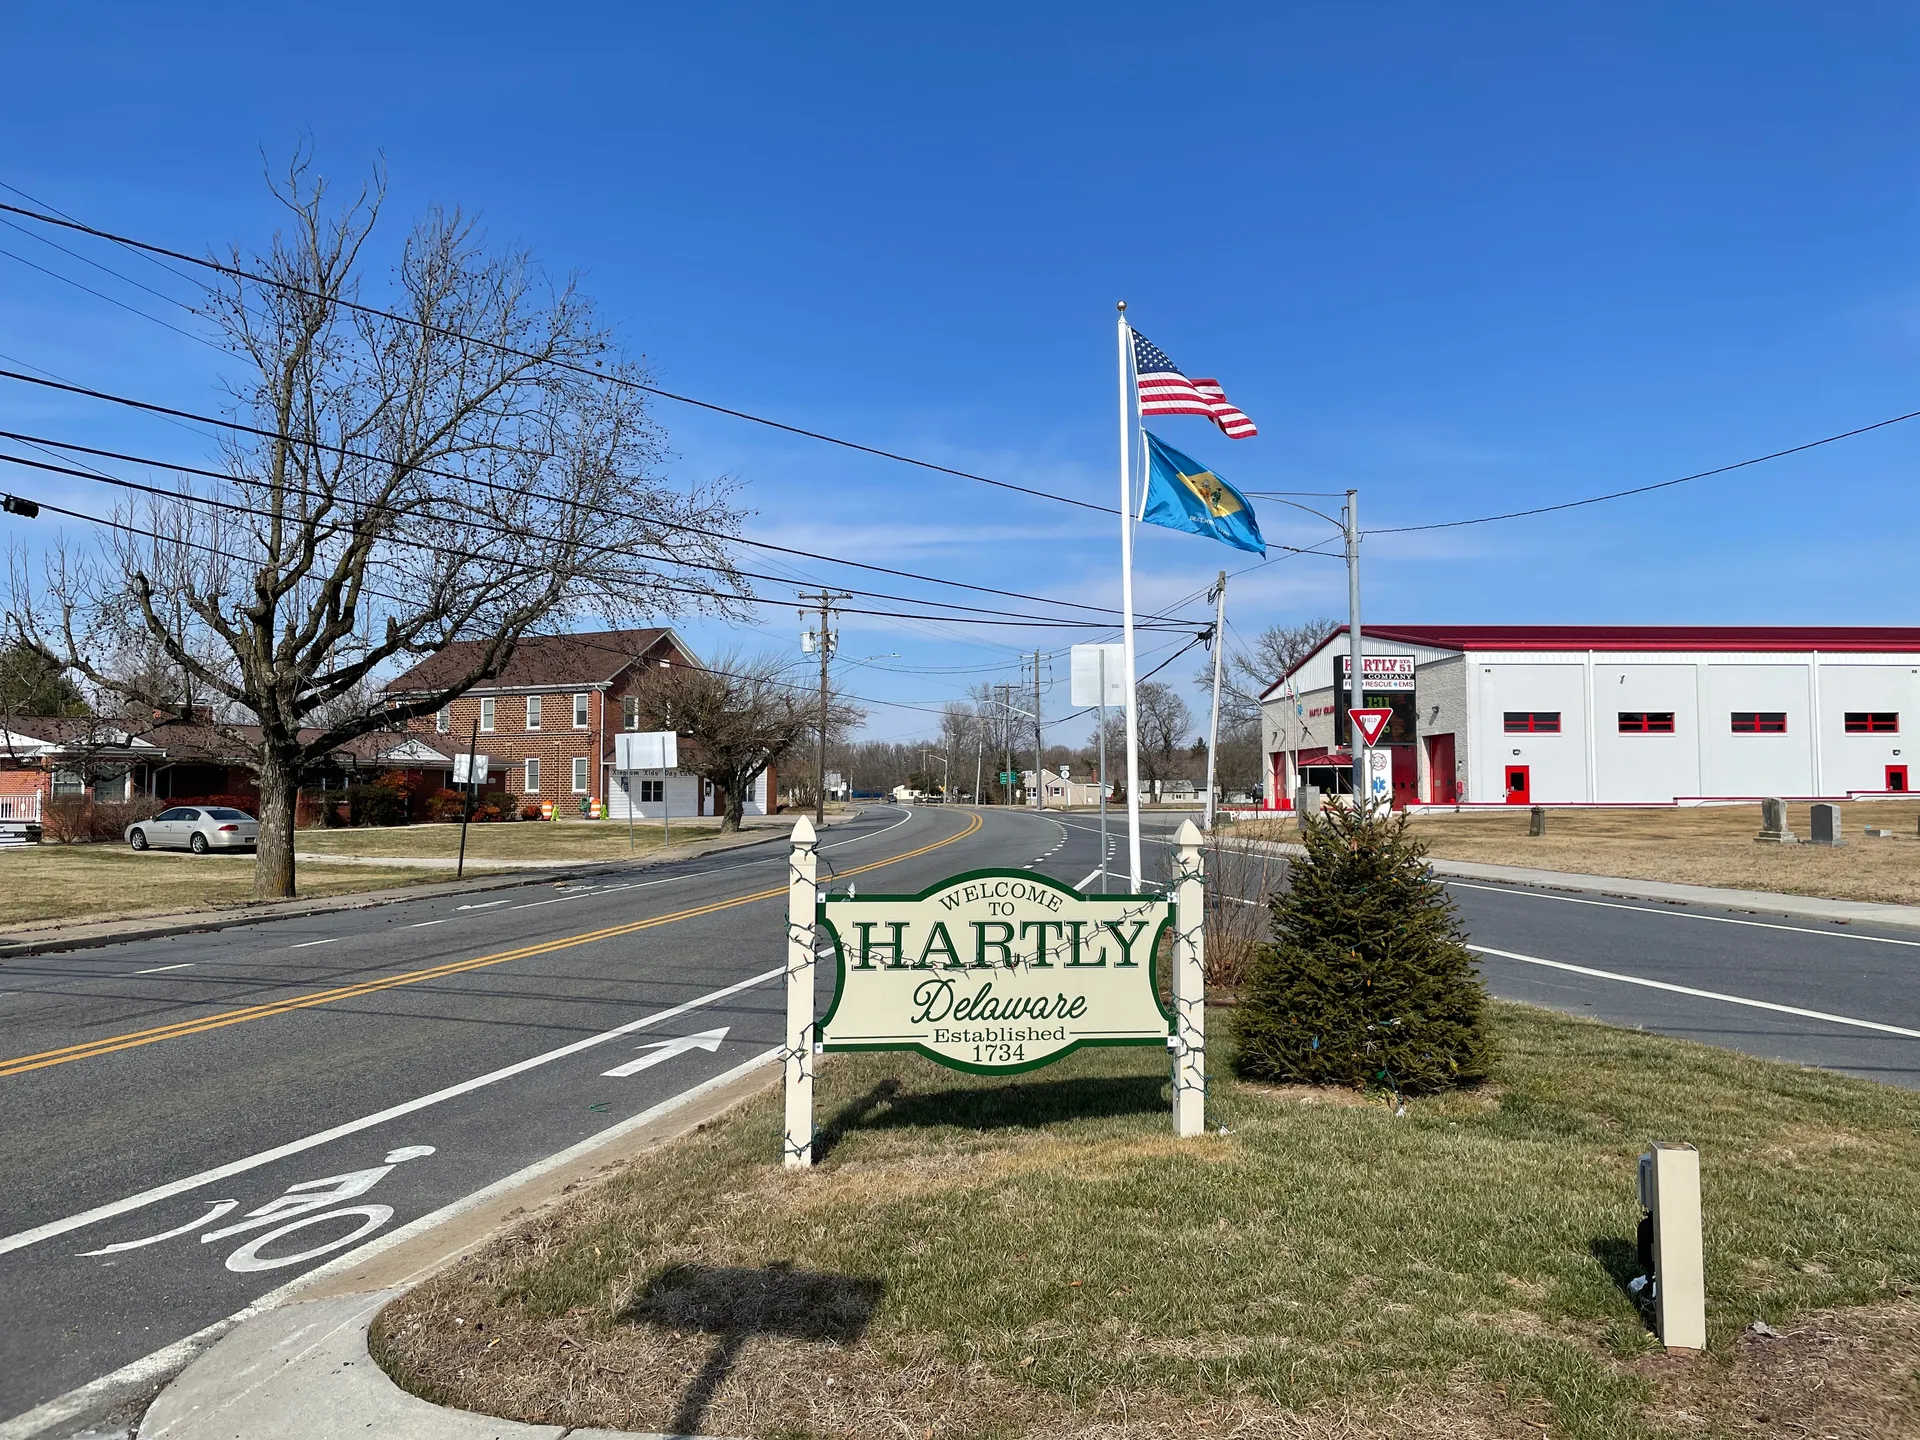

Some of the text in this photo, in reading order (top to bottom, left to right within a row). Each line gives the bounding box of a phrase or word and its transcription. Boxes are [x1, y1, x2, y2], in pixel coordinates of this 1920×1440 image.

[1344, 659, 1398, 672] HRTLY
[1399, 664, 1412, 672] 51
[665, 769, 677, 778] Day
[938, 881, 1063, 913] WELCOME
[988, 902, 1015, 916] TO
[851, 920, 1150, 971] HARTLY
[910, 978, 1088, 1024] Delaware
[933, 1026, 1066, 1044] Established
[972, 1044, 1025, 1062] 1734
